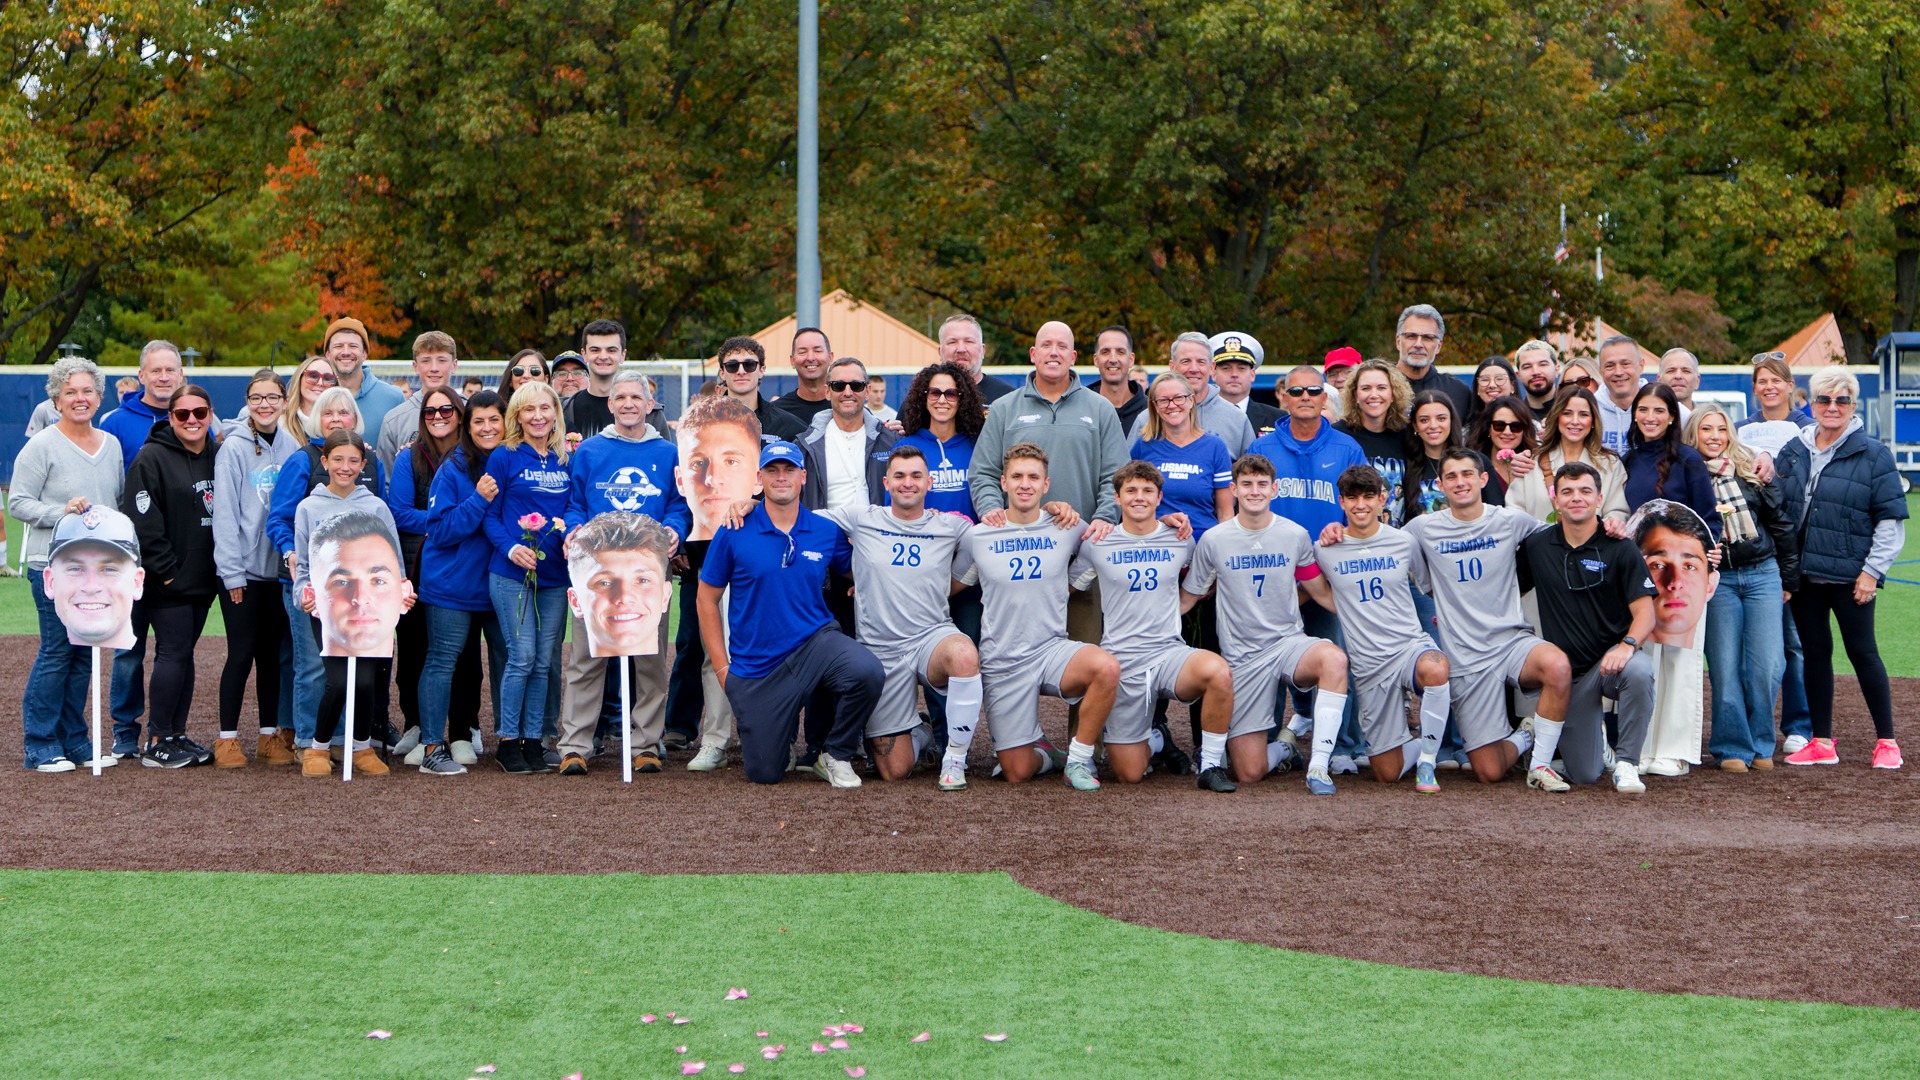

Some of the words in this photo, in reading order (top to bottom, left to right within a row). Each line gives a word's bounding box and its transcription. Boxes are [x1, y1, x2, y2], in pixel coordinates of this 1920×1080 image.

[525, 469, 571, 483] USMMA
[929, 469, 969, 483] SMM
[1161, 462, 1199, 475] USMMA
[1169, 472, 1189, 480] MOM
[933, 481, 963, 489] SOCCER
[994, 536, 1054, 554] USMMA
[1440, 536, 1496, 554] USMMA
[891, 543, 921, 567] 28
[1112, 549, 1171, 565] USMMA
[1230, 553, 1286, 570] USMMA
[1009, 556, 1042, 581] 22
[1339, 556, 1396, 575] USMMA
[1455, 557, 1483, 583] 10
[1127, 568, 1159, 592] 23
[1252, 574, 1266, 597] 7
[1356, 577, 1384, 603] 16
